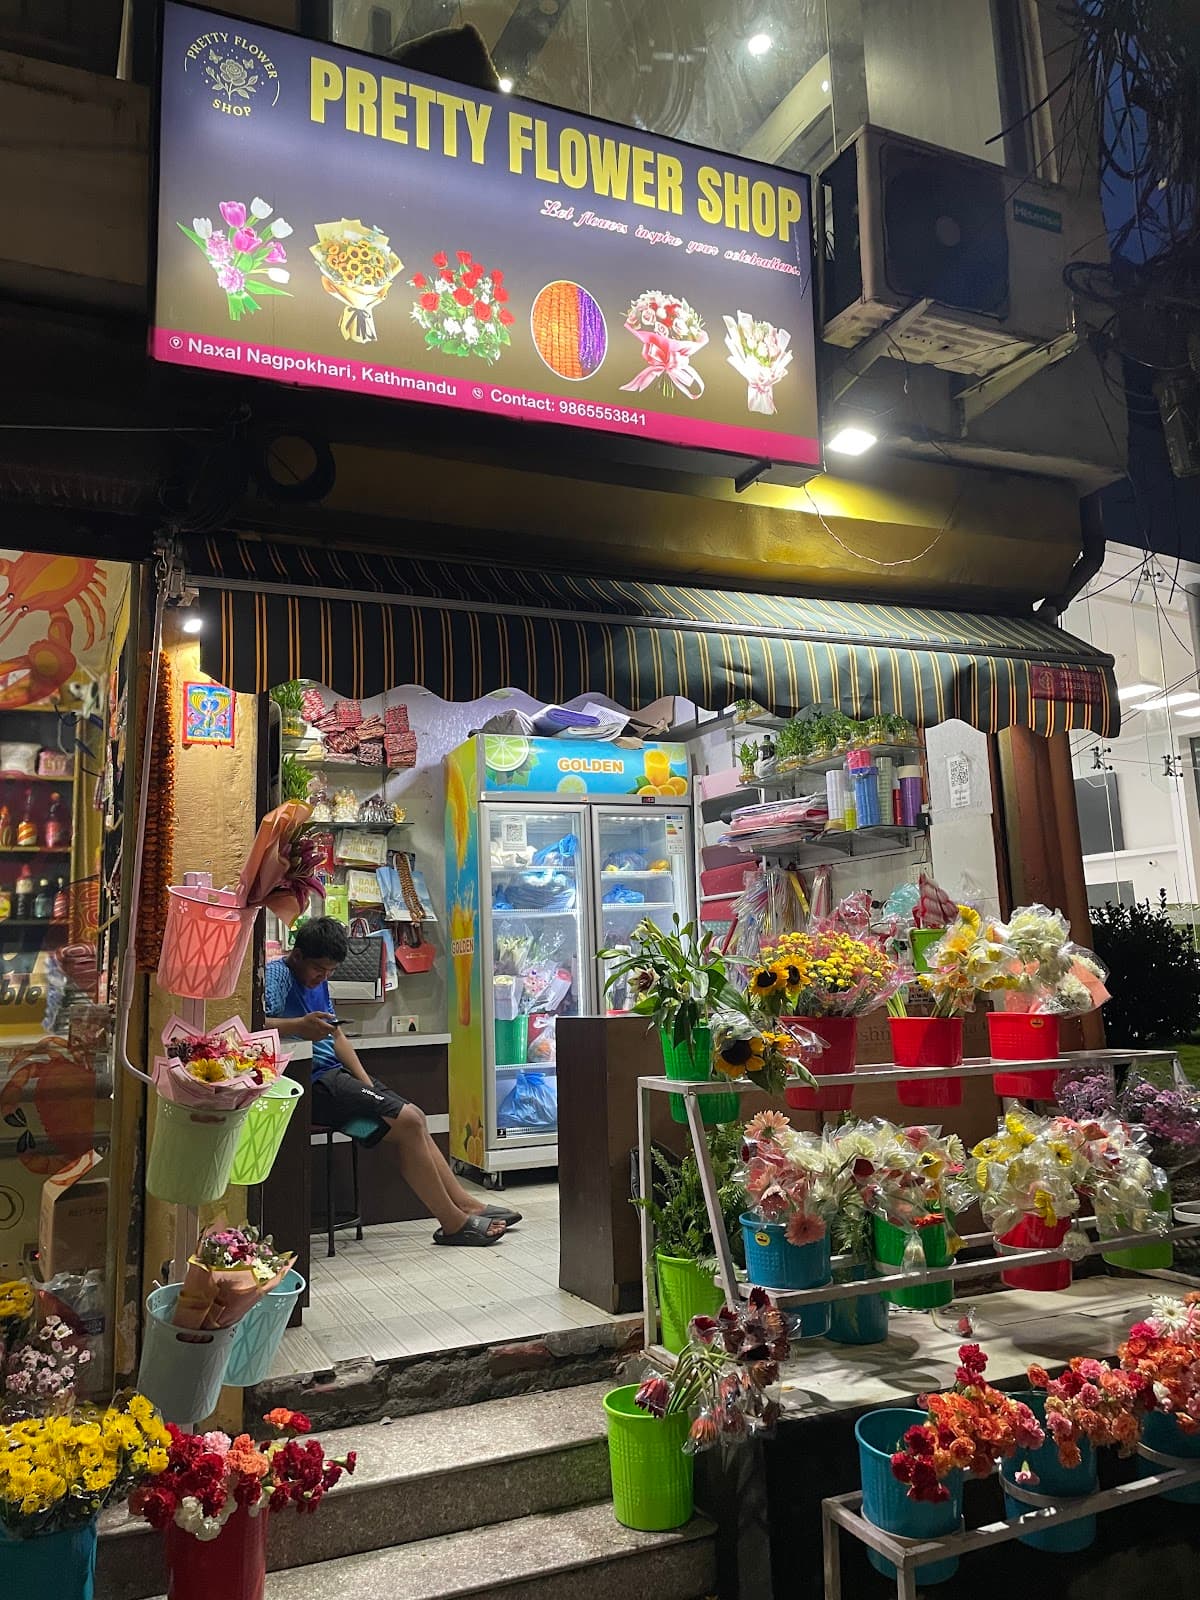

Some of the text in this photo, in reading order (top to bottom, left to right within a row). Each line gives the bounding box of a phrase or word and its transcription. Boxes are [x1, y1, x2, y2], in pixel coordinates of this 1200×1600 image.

[186, 32, 278, 79] PRETTY FLOWER
[212, 98, 252, 117] SHOP
[310, 55, 802, 242] PRETTY FLOWER SHOP
[540, 199, 573, 221] Let
[573, 210, 628, 234] flowers
[634, 224, 683, 247] inspire
[686, 239, 719, 256] your
[188, 337, 647, 427] Naxal Nagpokhari, Kathmandu Contact: 9865553841
[557, 757, 624, 775] GOLDEN
[451, 938, 475, 955] GOLDEN
